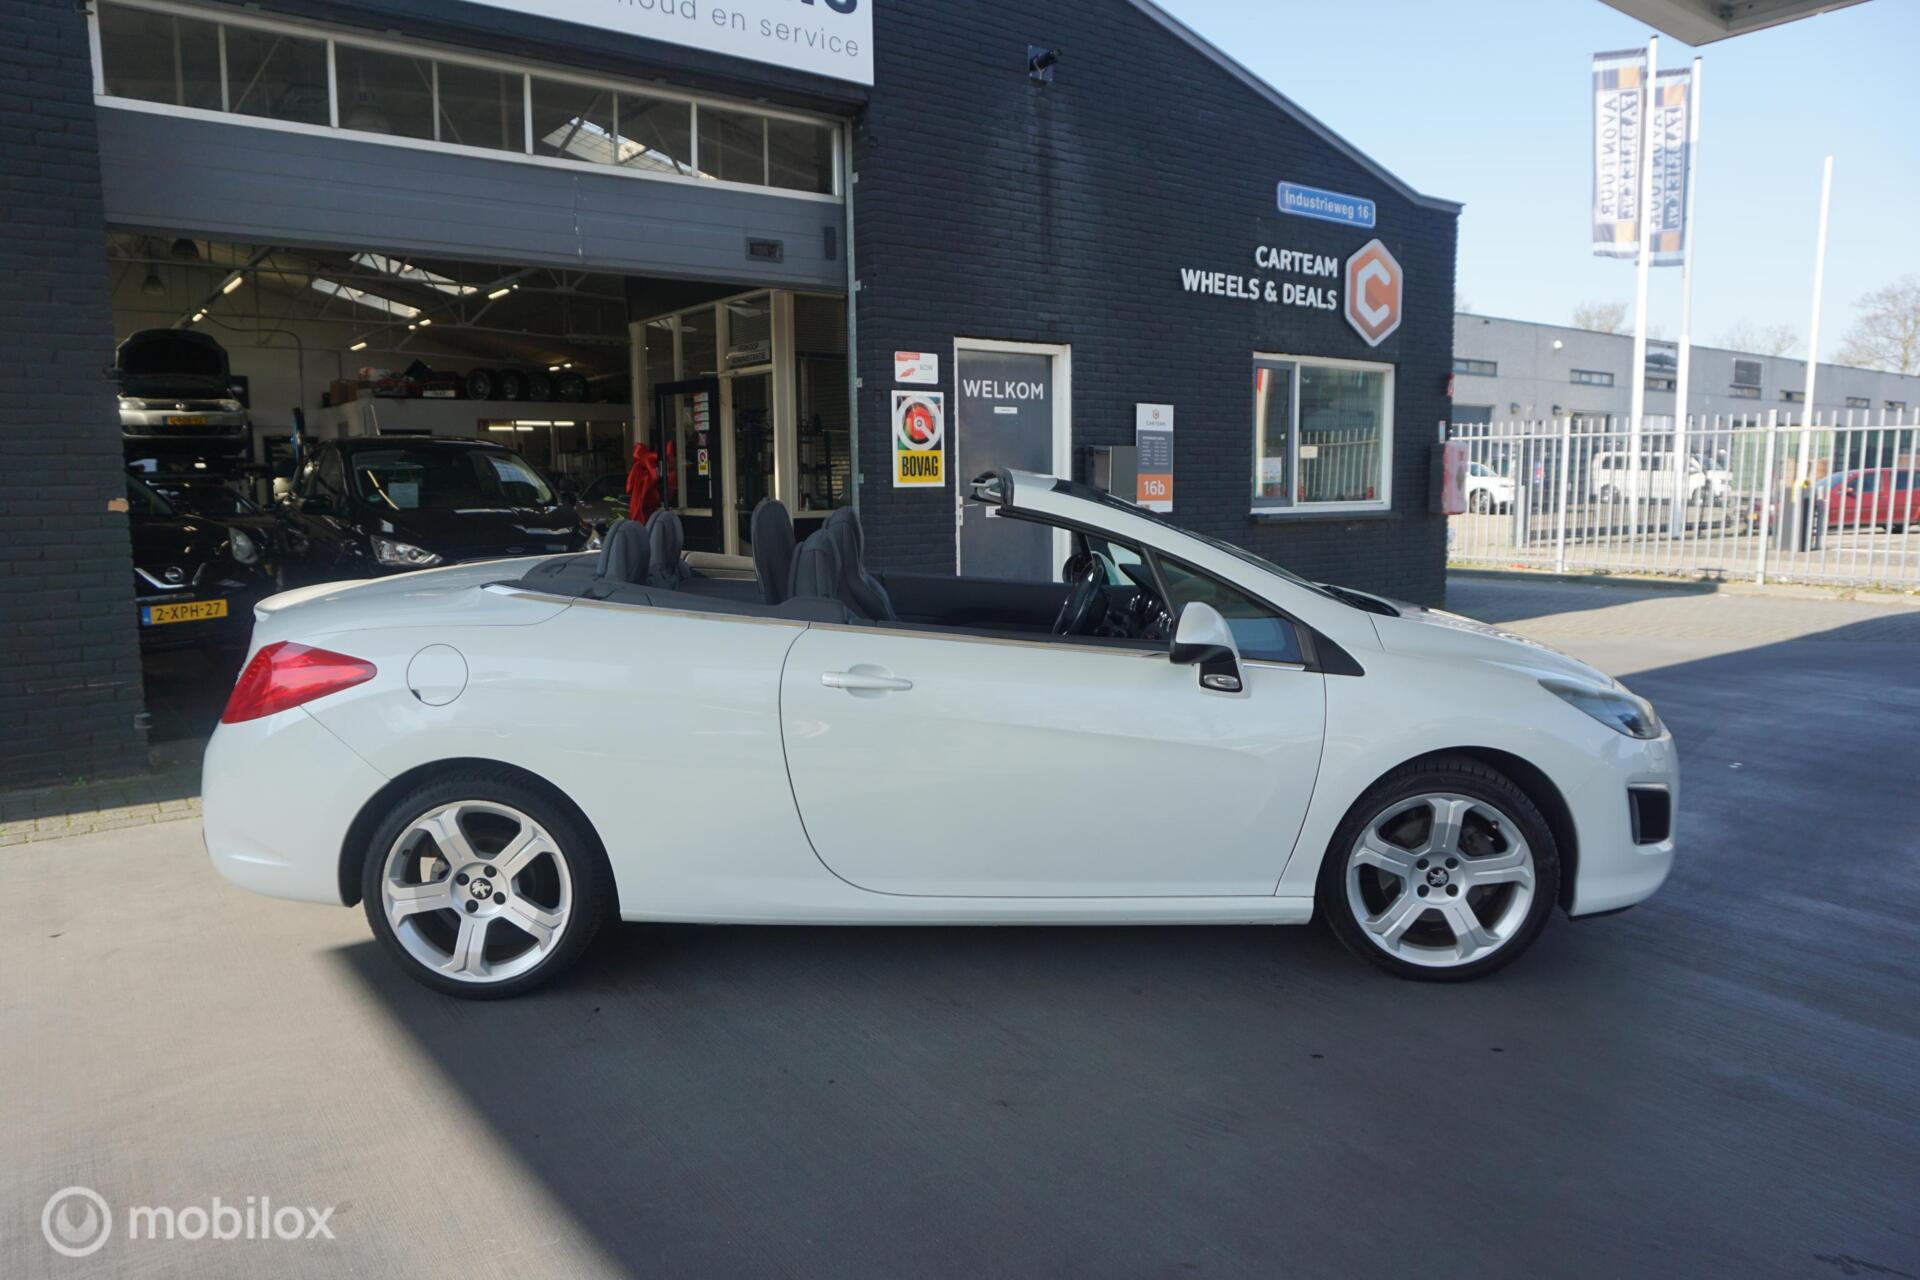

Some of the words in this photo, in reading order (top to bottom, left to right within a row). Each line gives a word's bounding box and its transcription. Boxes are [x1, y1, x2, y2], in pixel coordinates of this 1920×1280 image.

[711, 8, 746, 31] en
[760, 19, 859, 57] service
[1285, 190, 1354, 219] Industrieweg
[1358, 205, 1369, 219] 16
[1255, 246, 1338, 278] CARTEAM
[1181, 268, 1260, 300] WHEELS
[1264, 280, 1278, 303] &
[1282, 283, 1337, 310] DEALS
[963, 379, 1044, 400] WELKOM
[902, 456, 938, 477] BOVAG
[1143, 480, 1165, 496] 16b
[156, 602, 221, 621] 2-XPH-27
